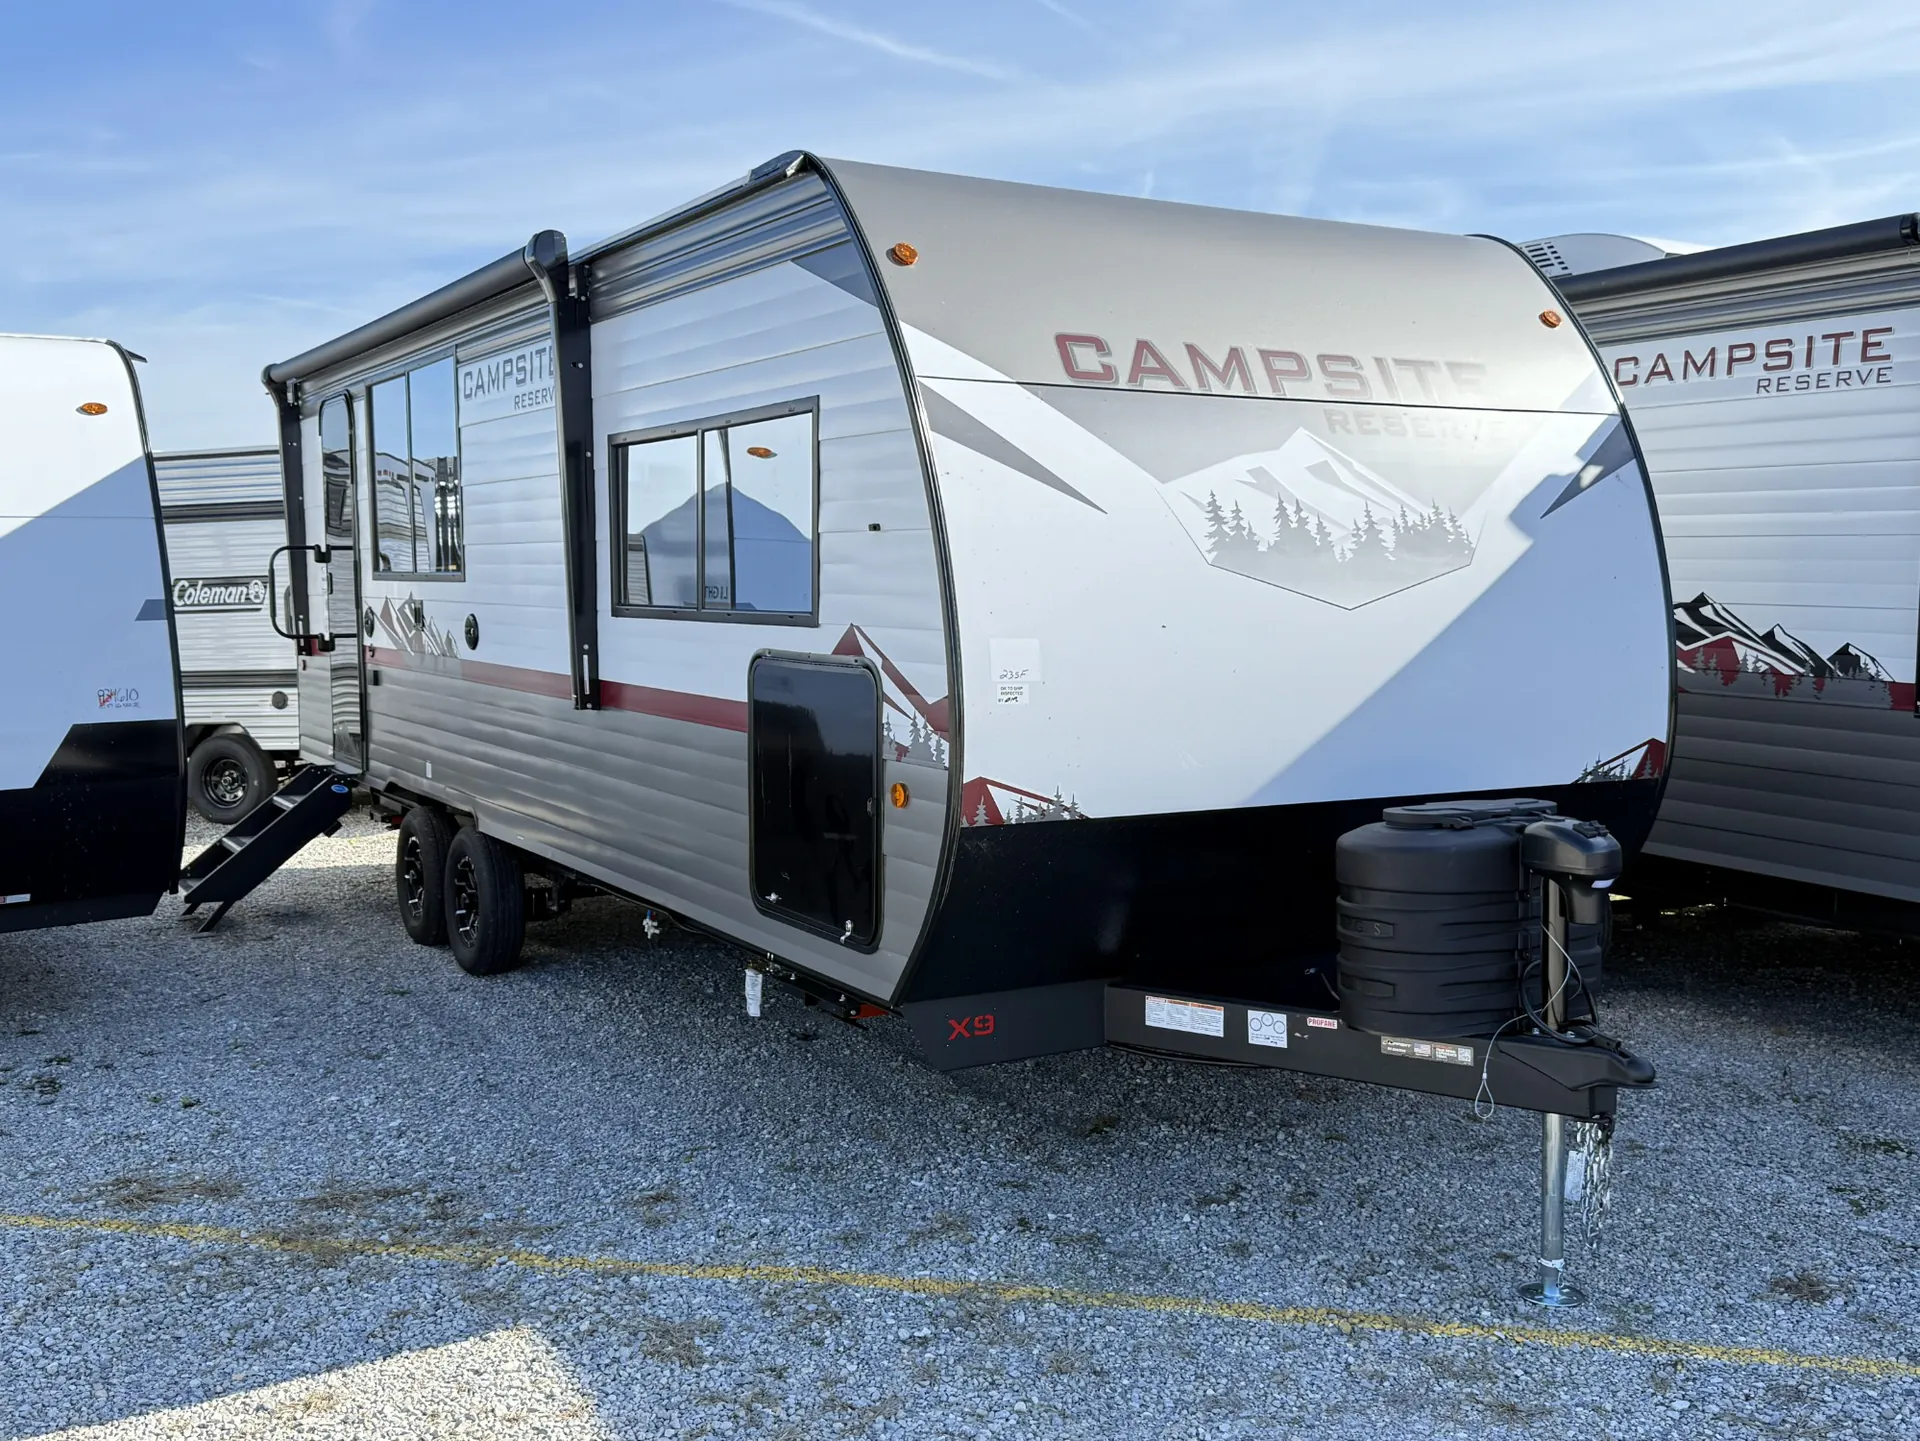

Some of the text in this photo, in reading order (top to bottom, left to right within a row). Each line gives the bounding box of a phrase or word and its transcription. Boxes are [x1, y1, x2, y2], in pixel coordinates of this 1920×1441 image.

[1054, 331, 1487, 401] CAMPSITE
[1613, 326, 1893, 387] CAMPSITE
[463, 345, 554, 400] CAMPSITE
[1756, 366, 1893, 395] RESERVE
[513, 385, 556, 410] RESERV
[173, 580, 248, 606] Coleman
[948, 1014, 995, 1040] X9
[1307, 1018, 1336, 1028] PROPANE
